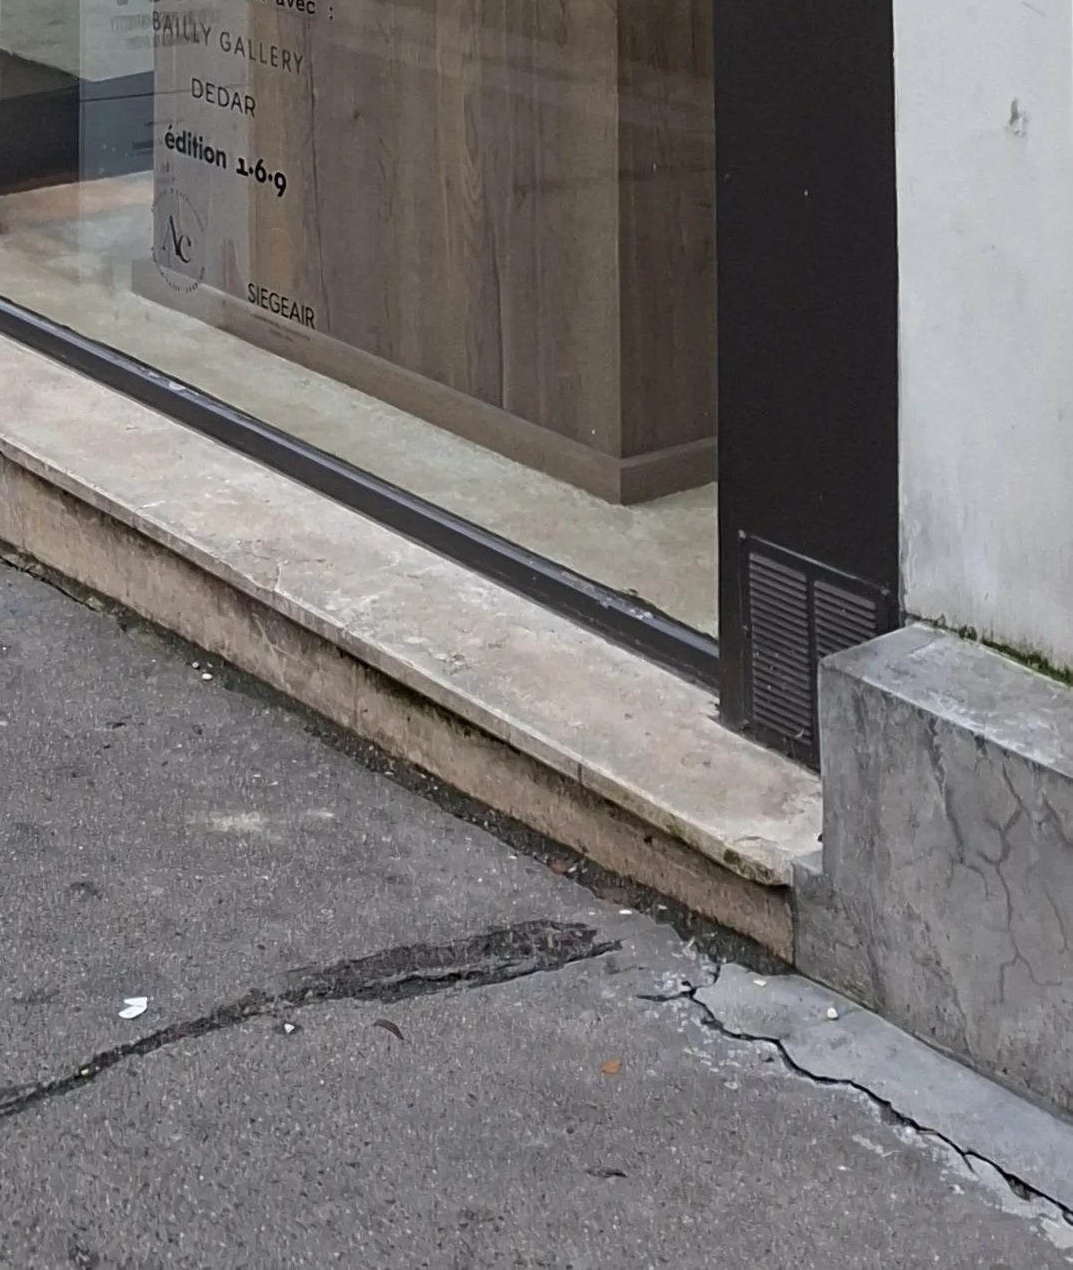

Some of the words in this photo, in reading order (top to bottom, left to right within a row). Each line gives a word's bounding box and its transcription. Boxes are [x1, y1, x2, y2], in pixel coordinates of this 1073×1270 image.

[152, 10, 212, 47] BAILLY
[219, 30, 304, 76] GALLERY
[191, 77, 257, 118] DEDAR
[164, 124, 227, 169] édition
[247, 282, 316, 330] SIEGEAIR
